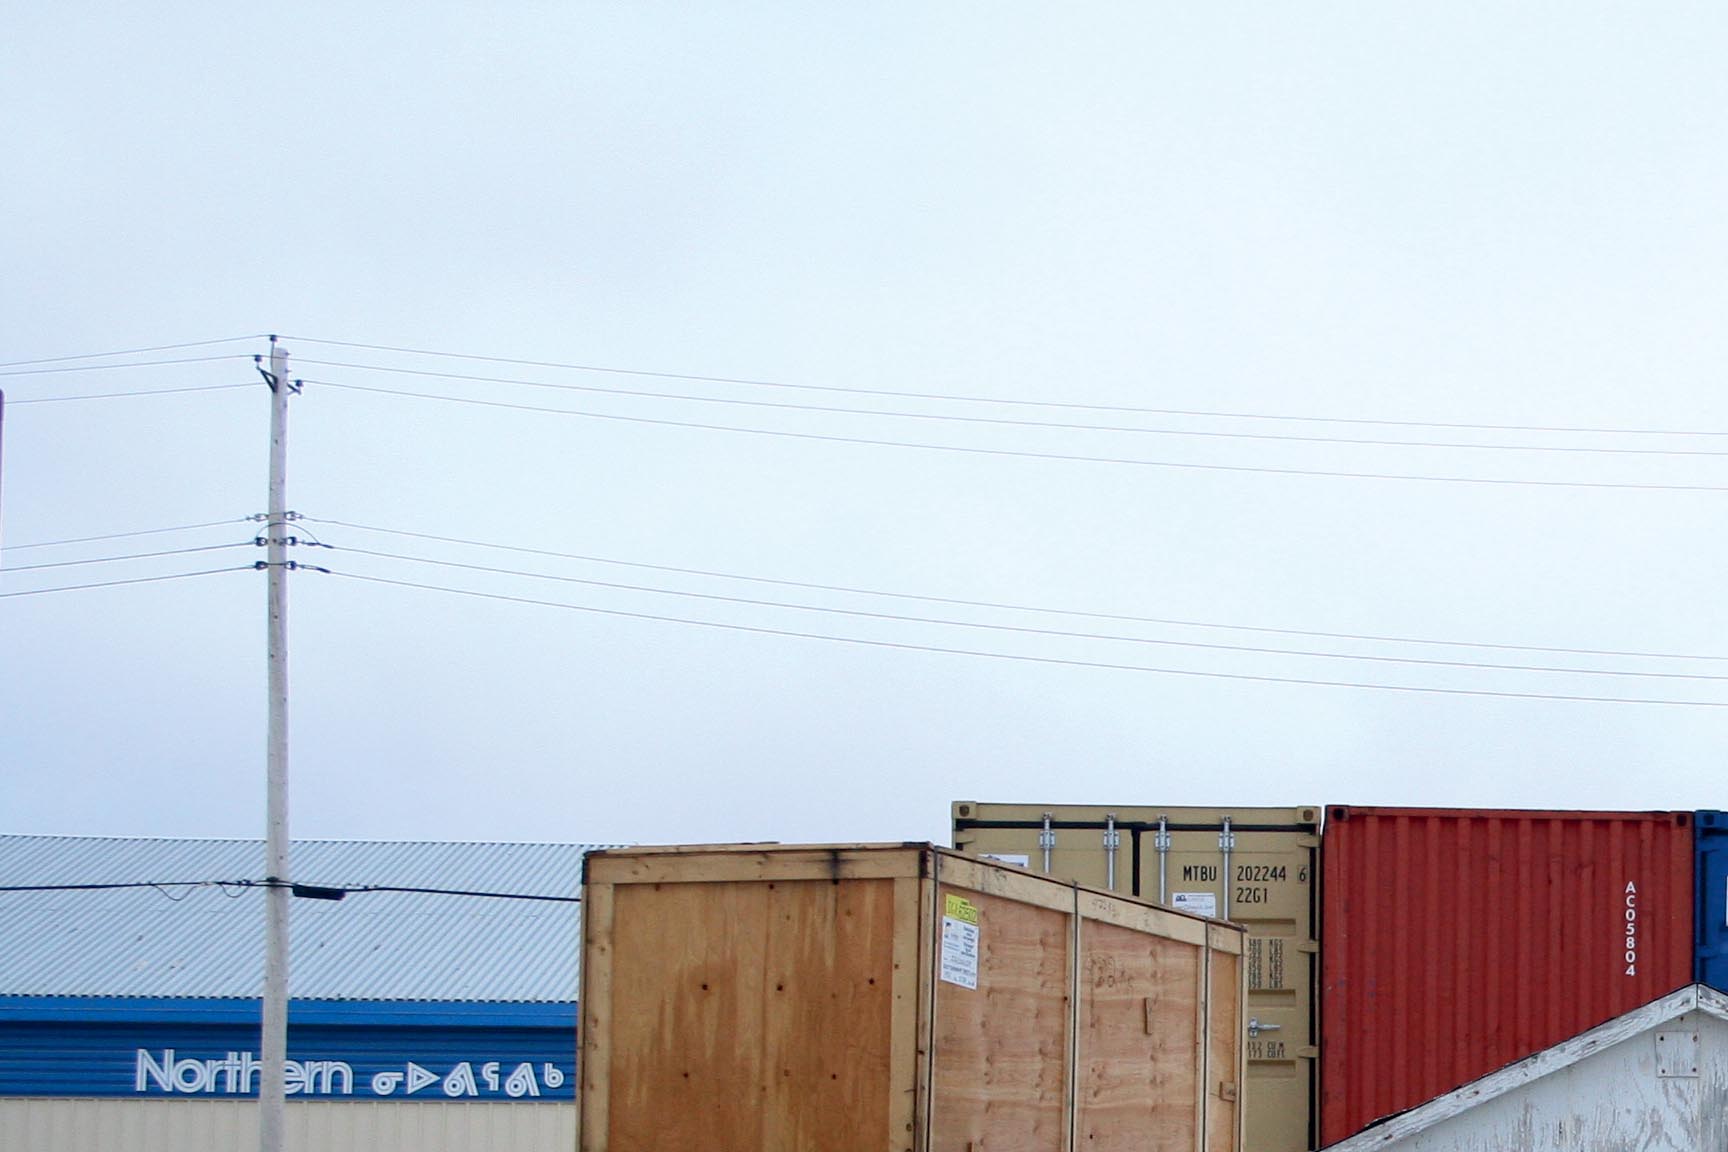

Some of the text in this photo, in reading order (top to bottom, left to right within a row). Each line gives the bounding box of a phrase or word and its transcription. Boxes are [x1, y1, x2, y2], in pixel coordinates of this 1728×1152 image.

[1183, 865, 1217, 881] MTBU
[1237, 865, 1286, 881] 202244
[1236, 888, 1267, 904] 22G1
[136, 1048, 353, 1094] Northern
